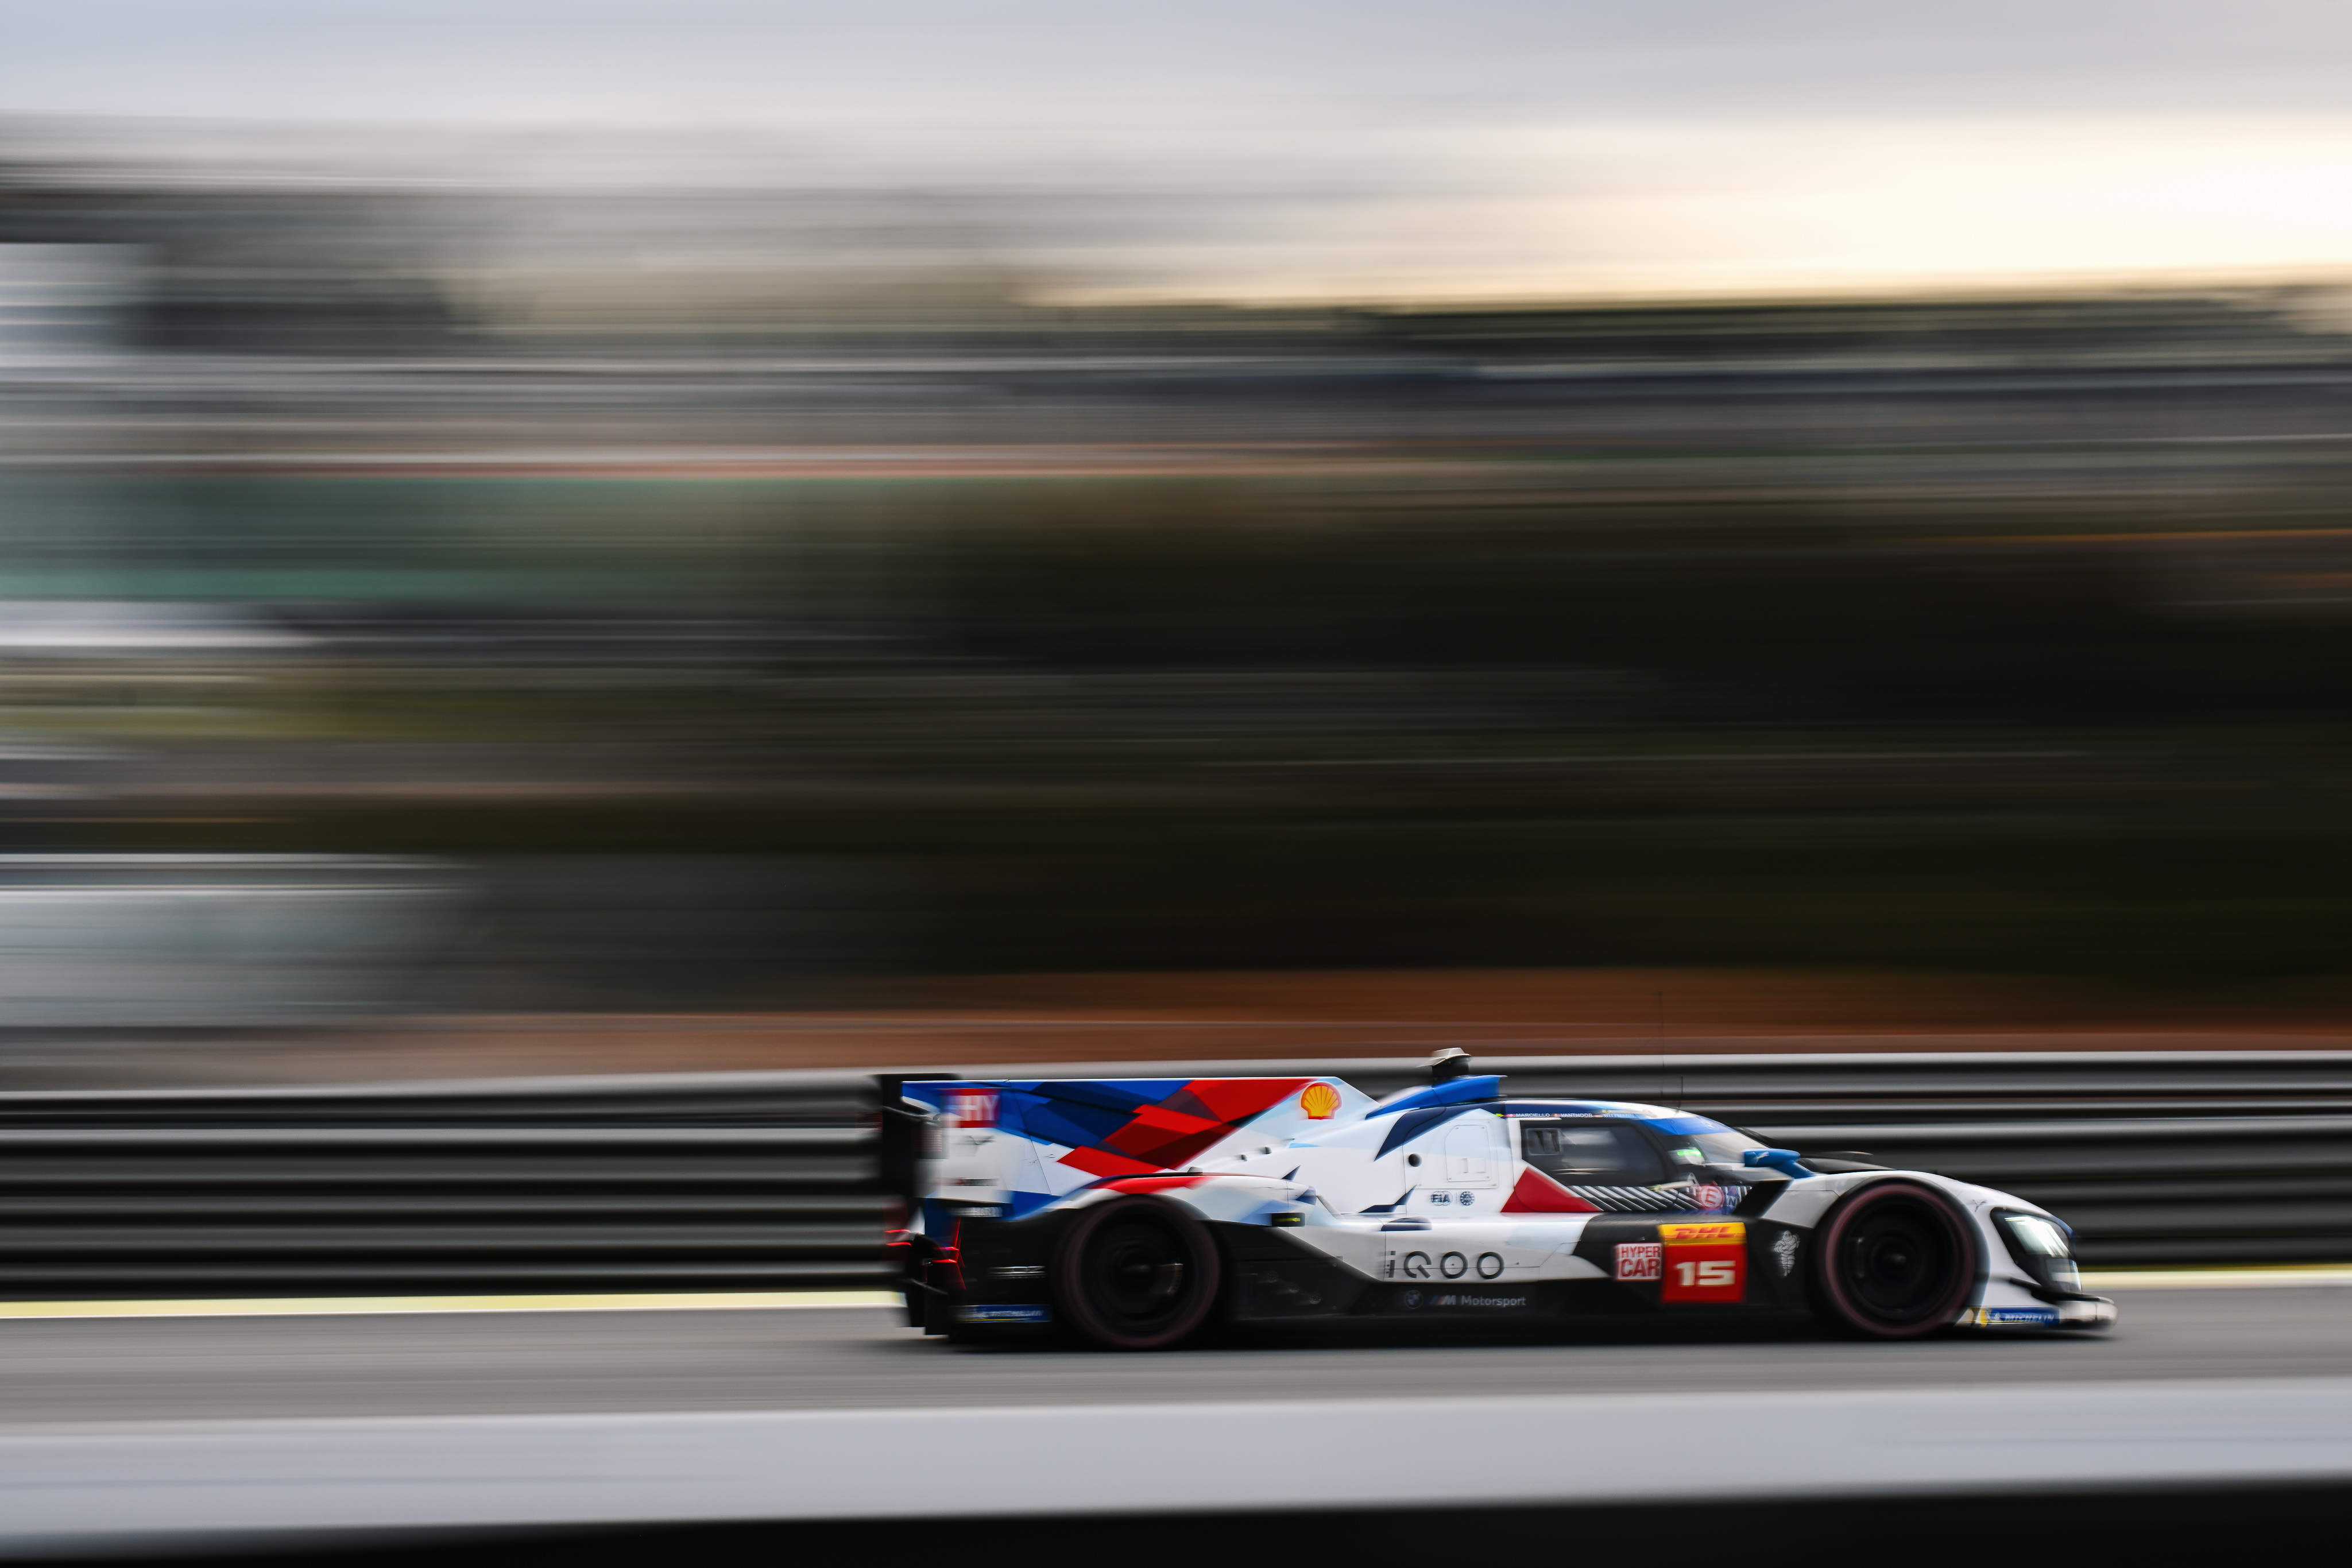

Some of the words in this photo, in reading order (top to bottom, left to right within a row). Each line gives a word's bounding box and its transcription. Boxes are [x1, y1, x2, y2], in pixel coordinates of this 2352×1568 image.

[1432, 1194, 1451, 1203] FIA
[1705, 1188, 1719, 1205] E
[1674, 1226, 1736, 1238] DHL
[1622, 1245, 1661, 1258] HYPER
[1389, 1250, 1504, 1279] iQOO
[1621, 1258, 1661, 1277] CAR
[1676, 1260, 1736, 1287] 15
[1461, 1295, 1526, 1308] Motorsport
